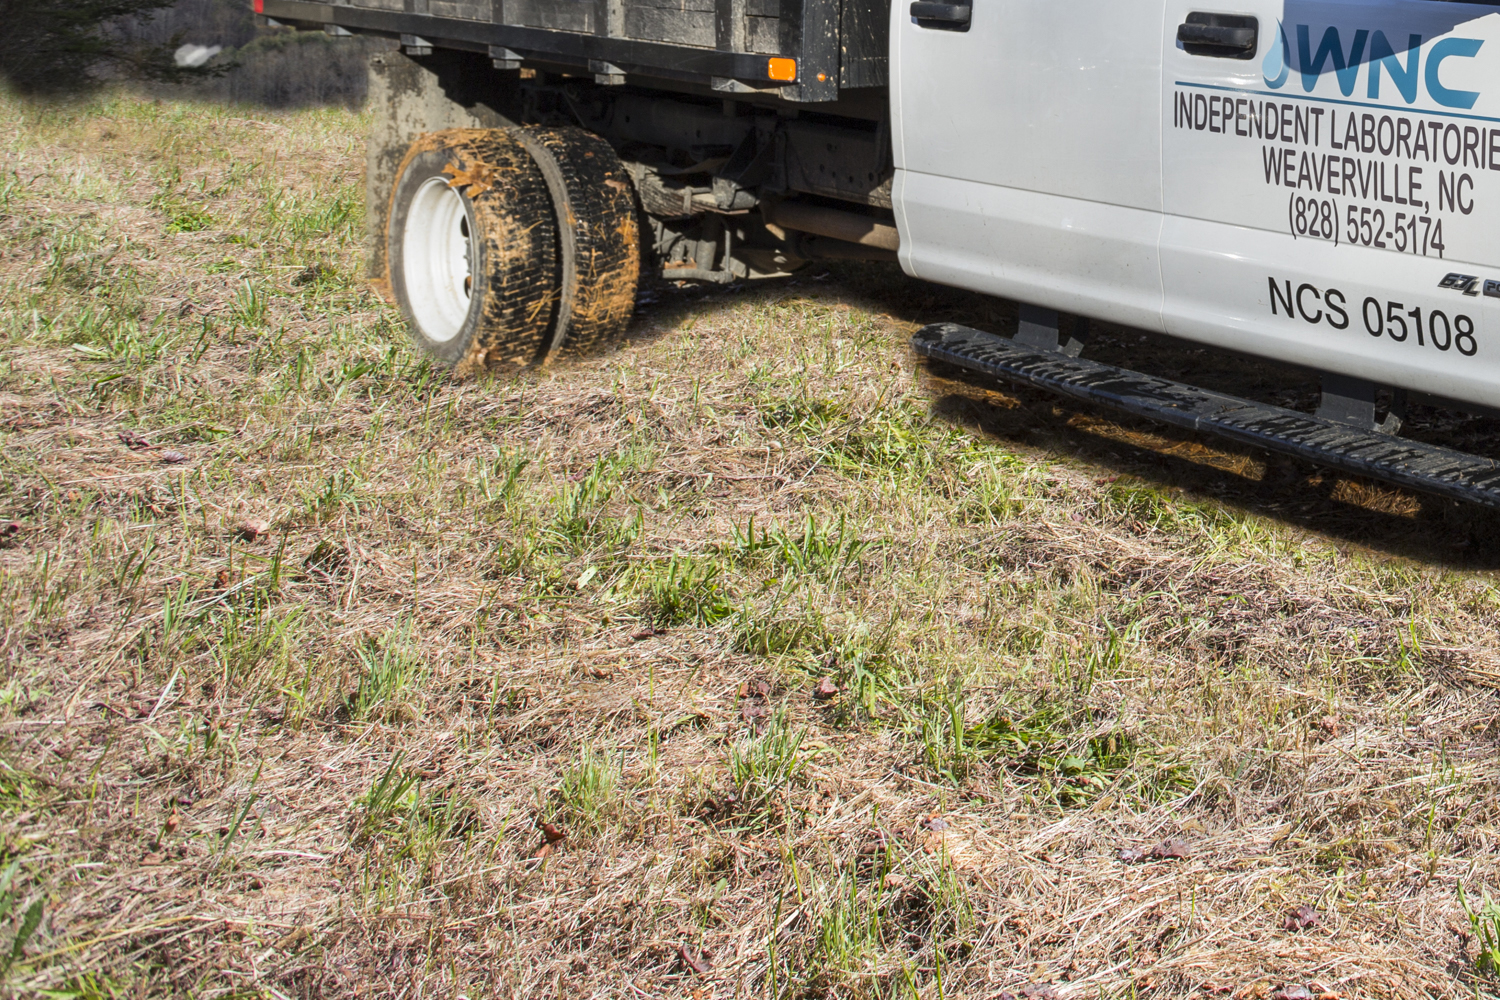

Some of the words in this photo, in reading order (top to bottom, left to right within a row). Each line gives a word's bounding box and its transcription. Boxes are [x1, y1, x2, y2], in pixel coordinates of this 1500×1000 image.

[1295, 23, 1485, 110] WNC
[1174, 90, 1325, 147] INDEPENDENT
[1262, 145, 1430, 215] WEAVERVILLE,
[1438, 169, 1475, 216] NC
[1288, 191, 1340, 248] (828)
[1346, 204, 1445, 259] 552-5174
[1267, 276, 1350, 331] NCS
[1361, 296, 1478, 357] 05108
